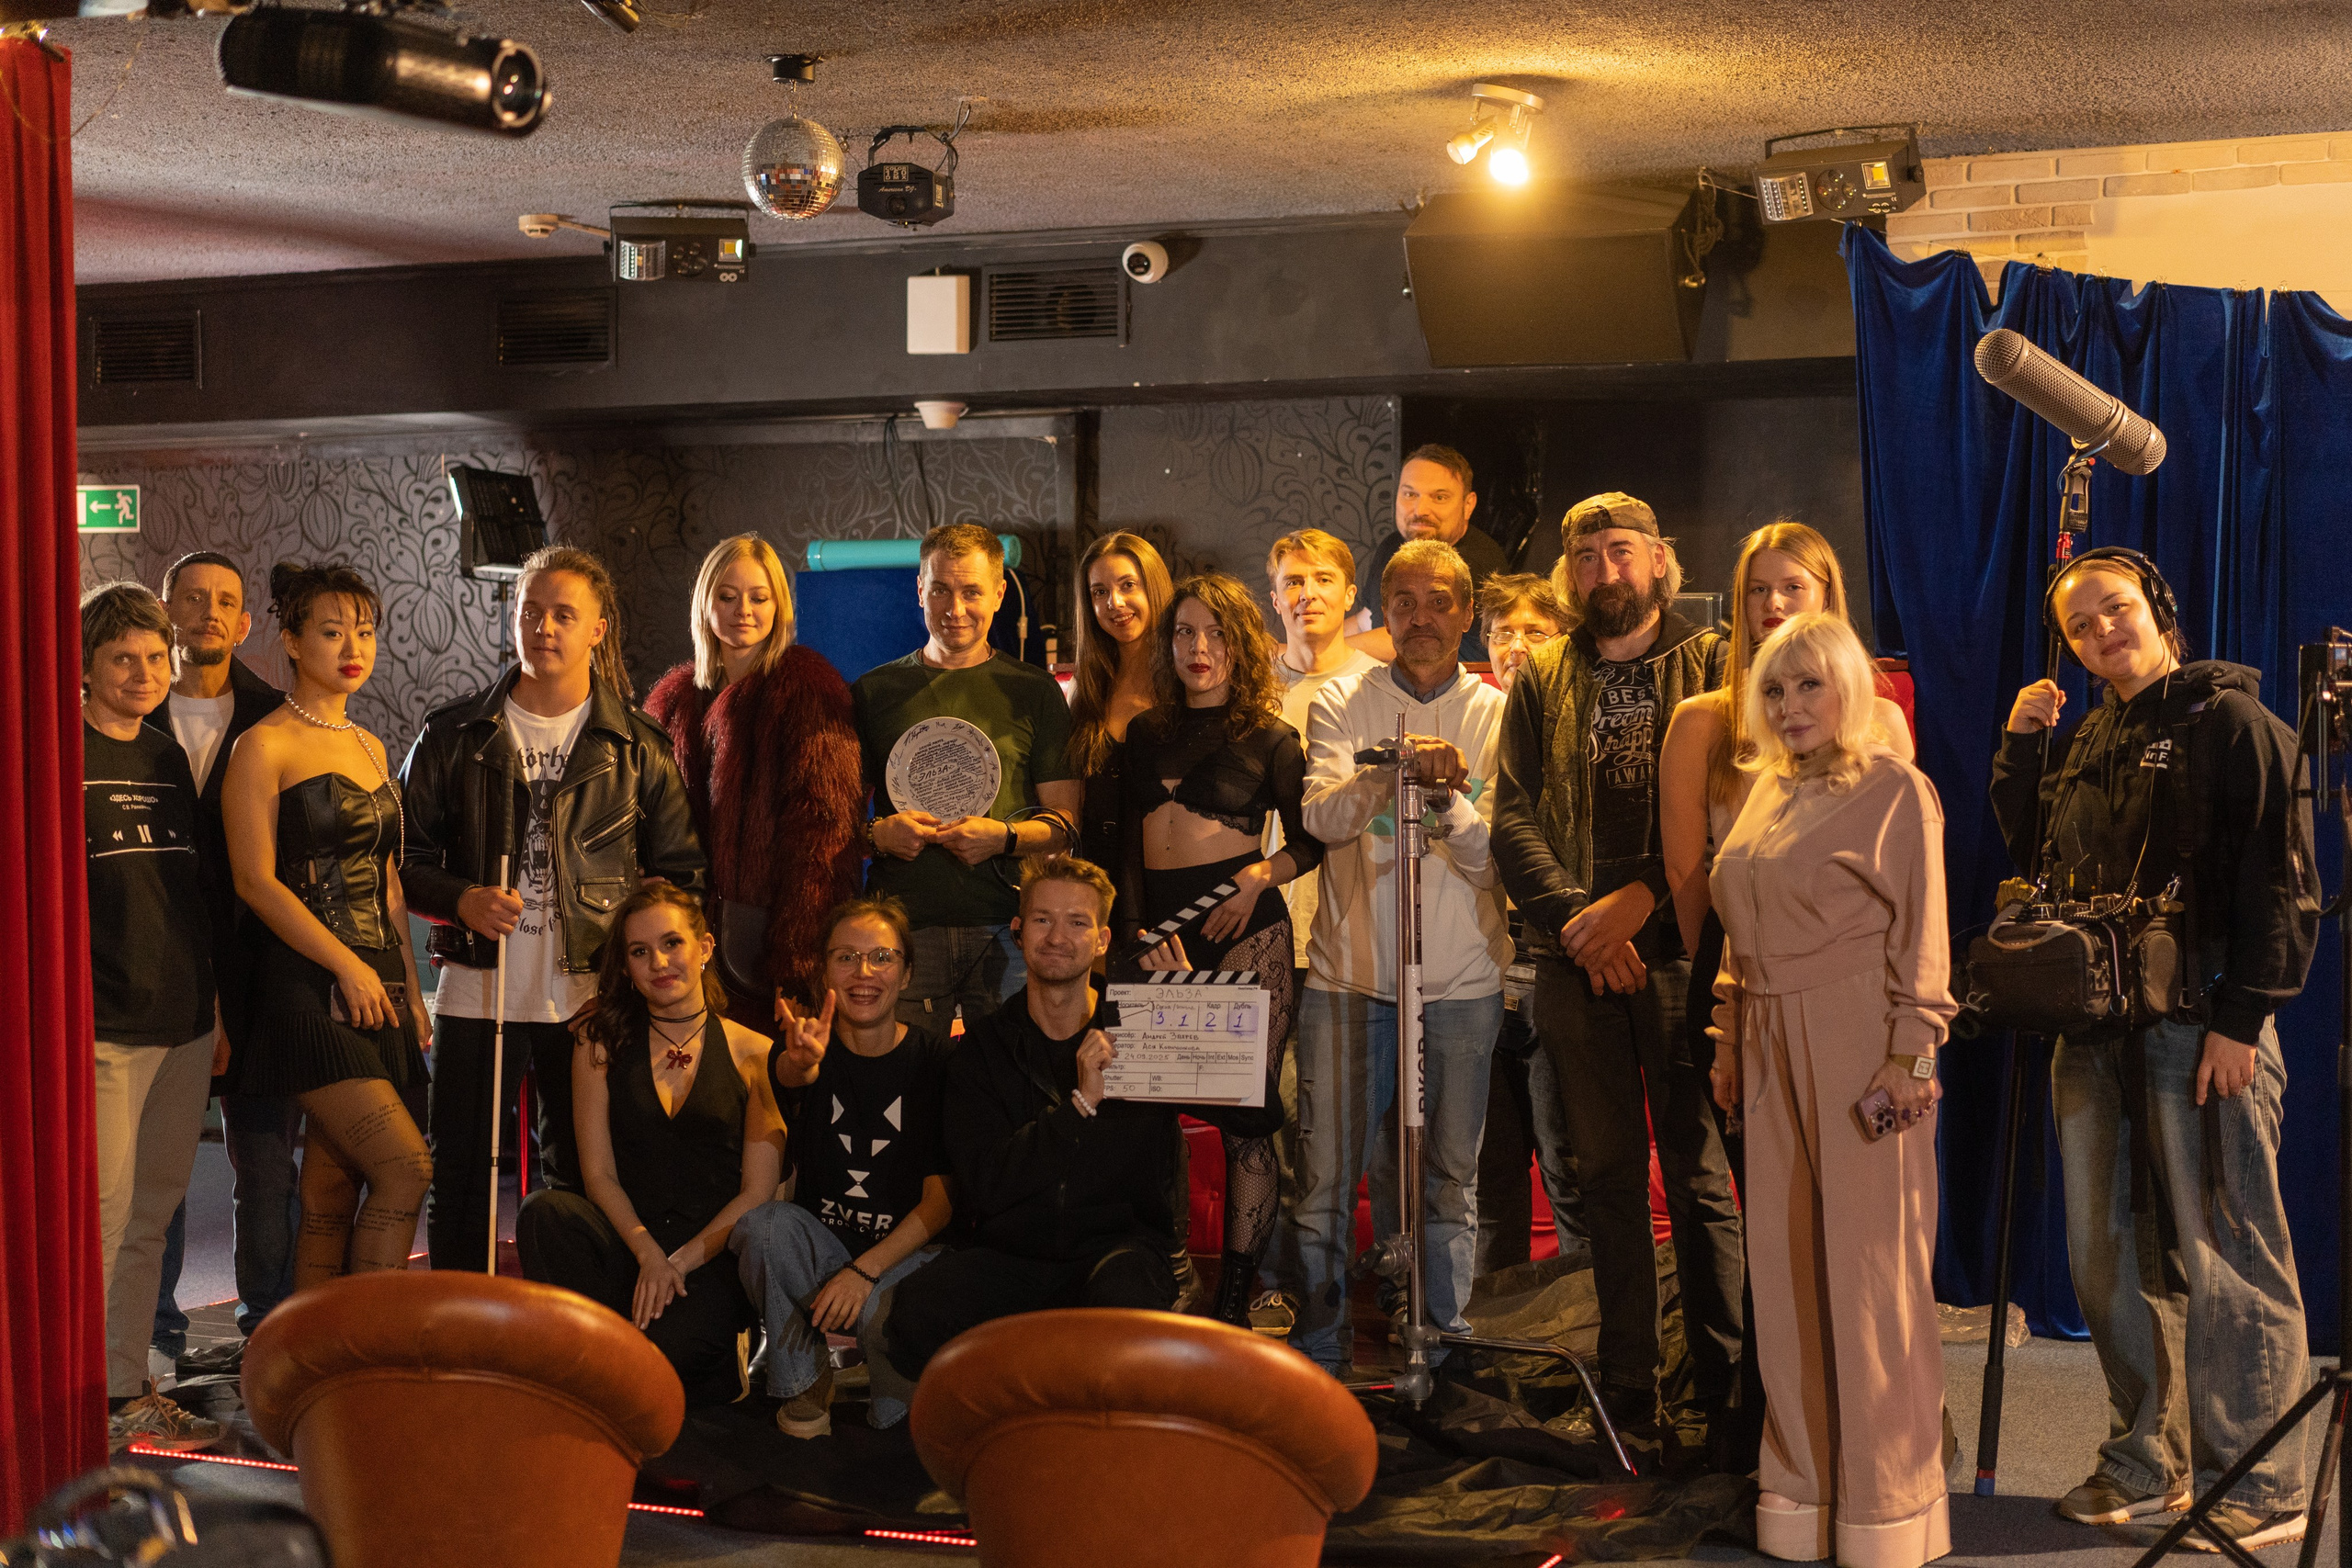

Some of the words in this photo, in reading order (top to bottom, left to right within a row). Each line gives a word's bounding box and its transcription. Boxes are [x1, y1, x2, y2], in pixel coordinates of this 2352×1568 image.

[918, 764, 948, 782] ЭЛЬЗА
[1234, 1002, 1251, 1010] Дубль
[1205, 1012, 1216, 1027] 2
[1233, 1012, 1244, 1028] 1
[820, 1198, 893, 1230] ZVER
